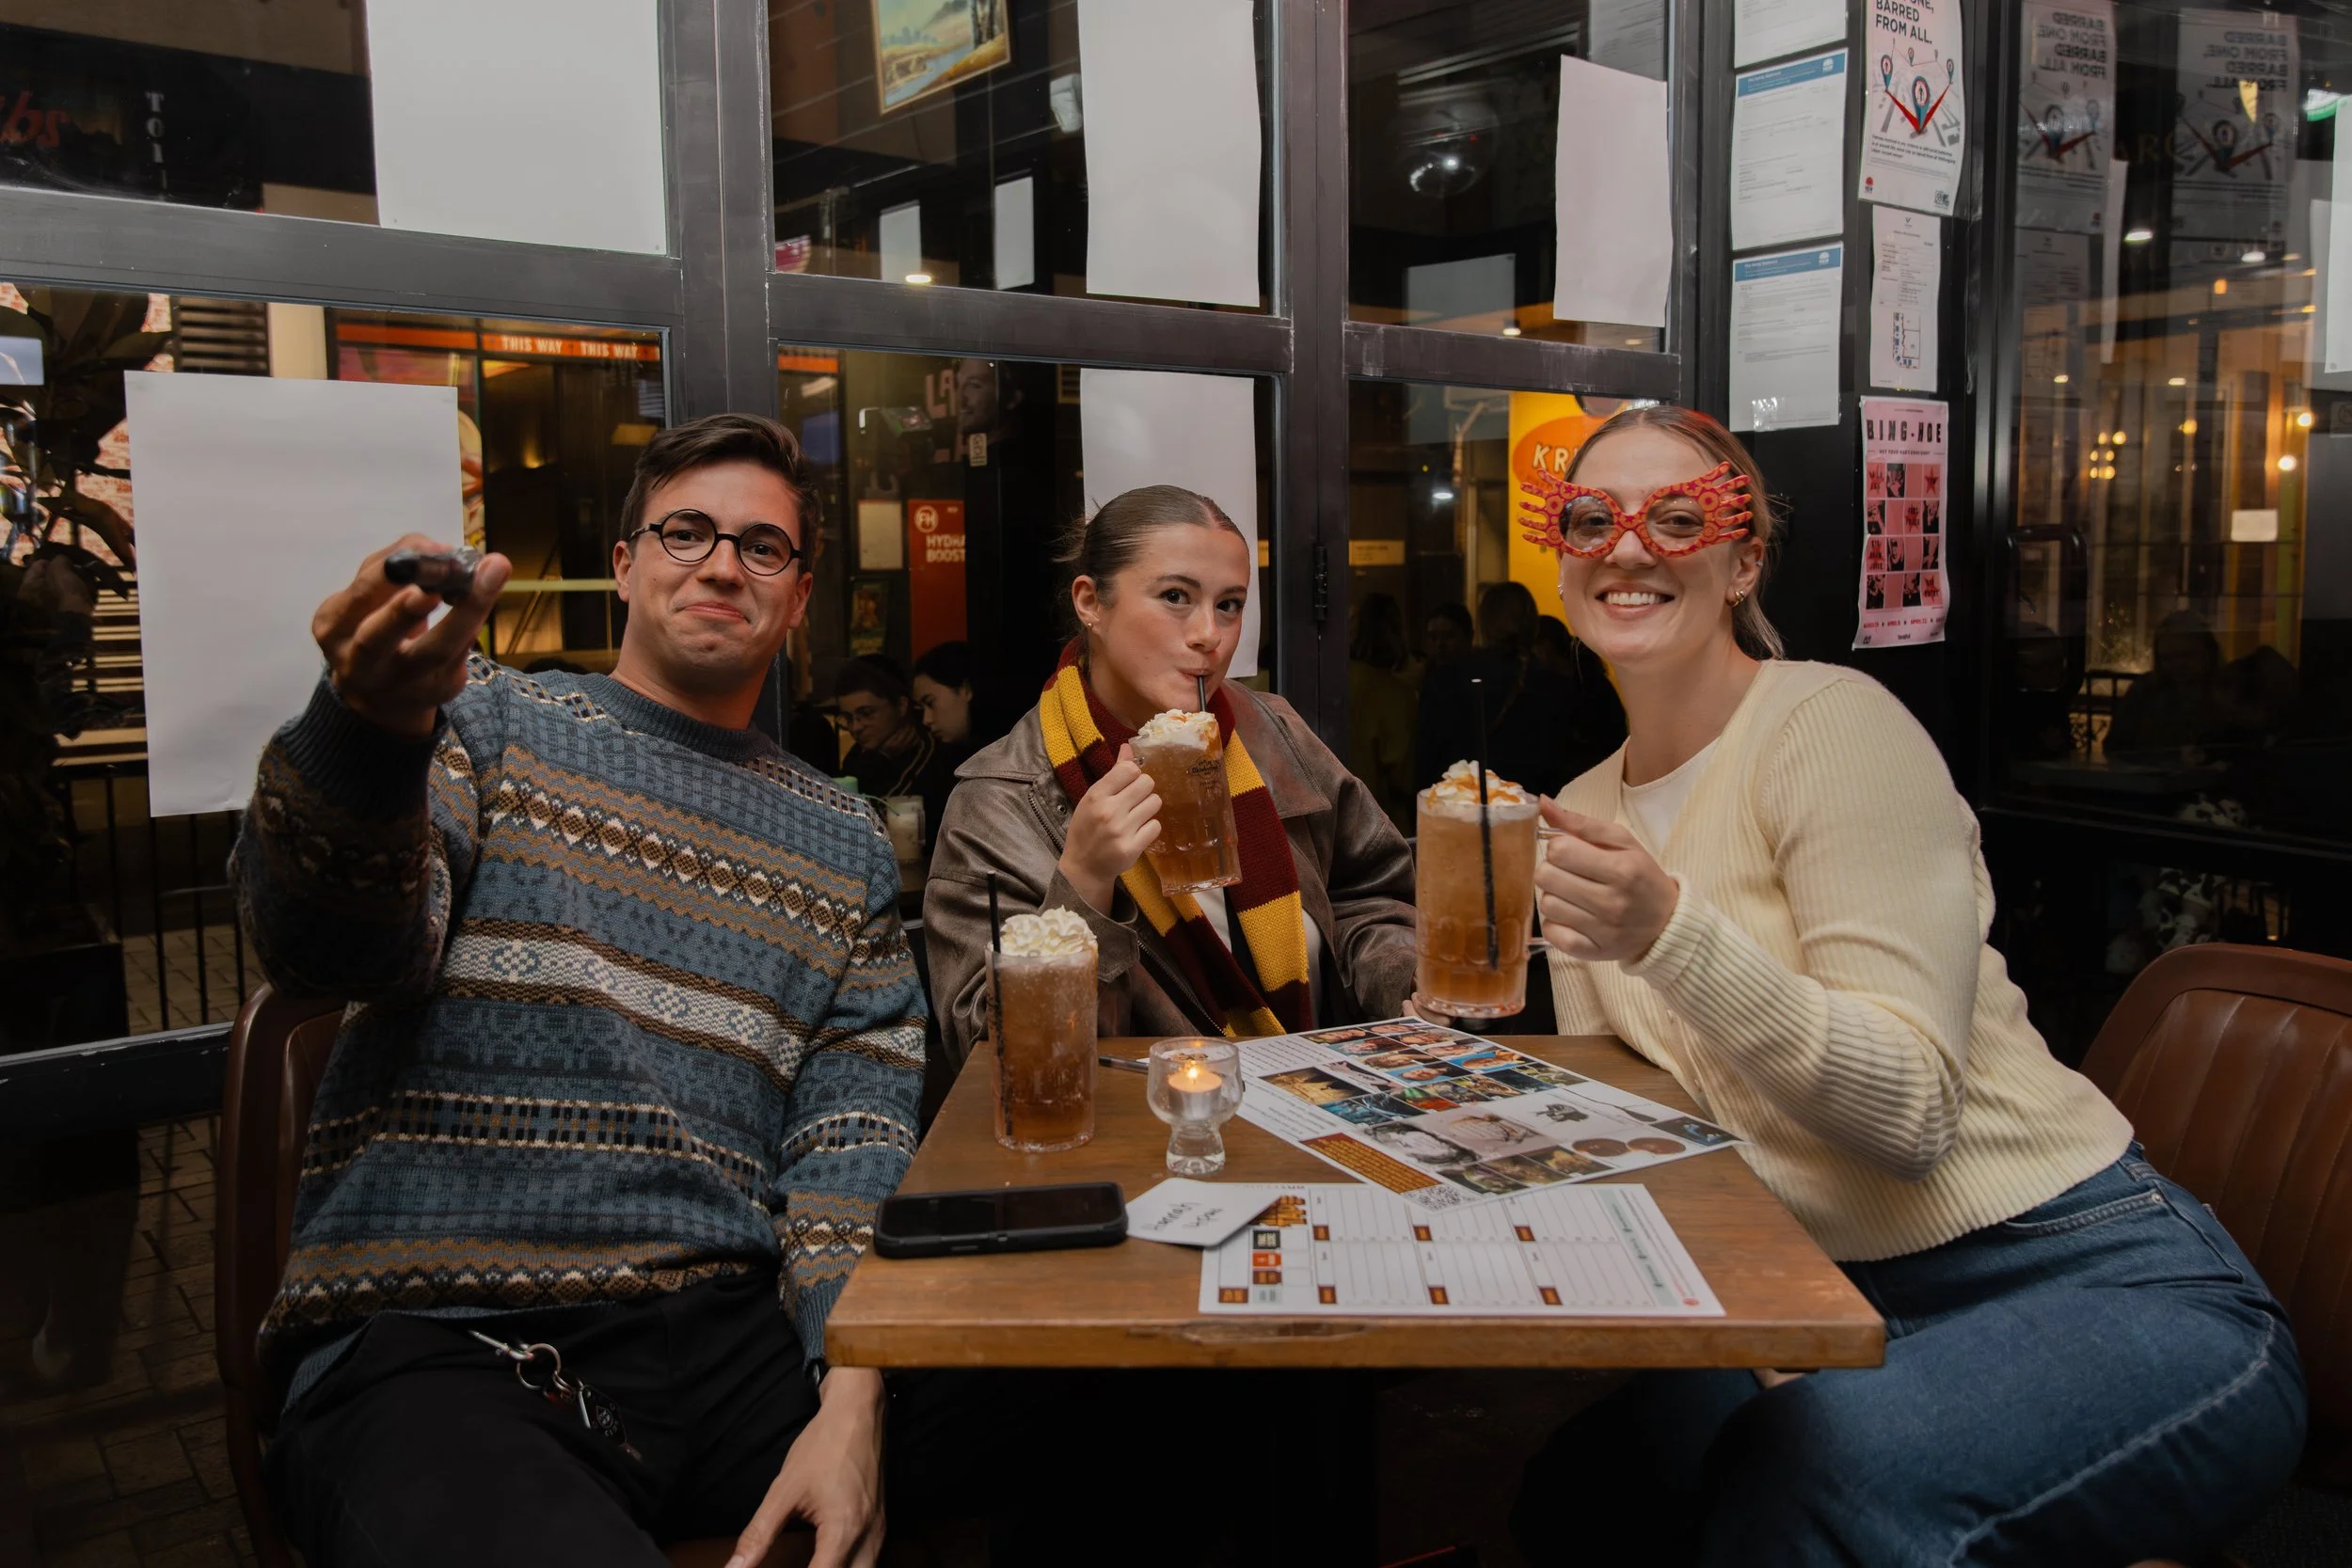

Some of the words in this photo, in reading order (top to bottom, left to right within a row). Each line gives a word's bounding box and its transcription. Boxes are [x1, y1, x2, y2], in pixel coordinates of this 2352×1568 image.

[1876, 0, 1919, 23] BARRED
[1876, 14, 1907, 37] FROM
[1910, 25, 1932, 44] ALL.
[501, 335, 532, 352] THIS
[535, 338, 563, 355] WAY
[580, 341, 610, 357] THIS
[612, 344, 638, 360] WAY
[1533, 444, 1579, 473] KR
